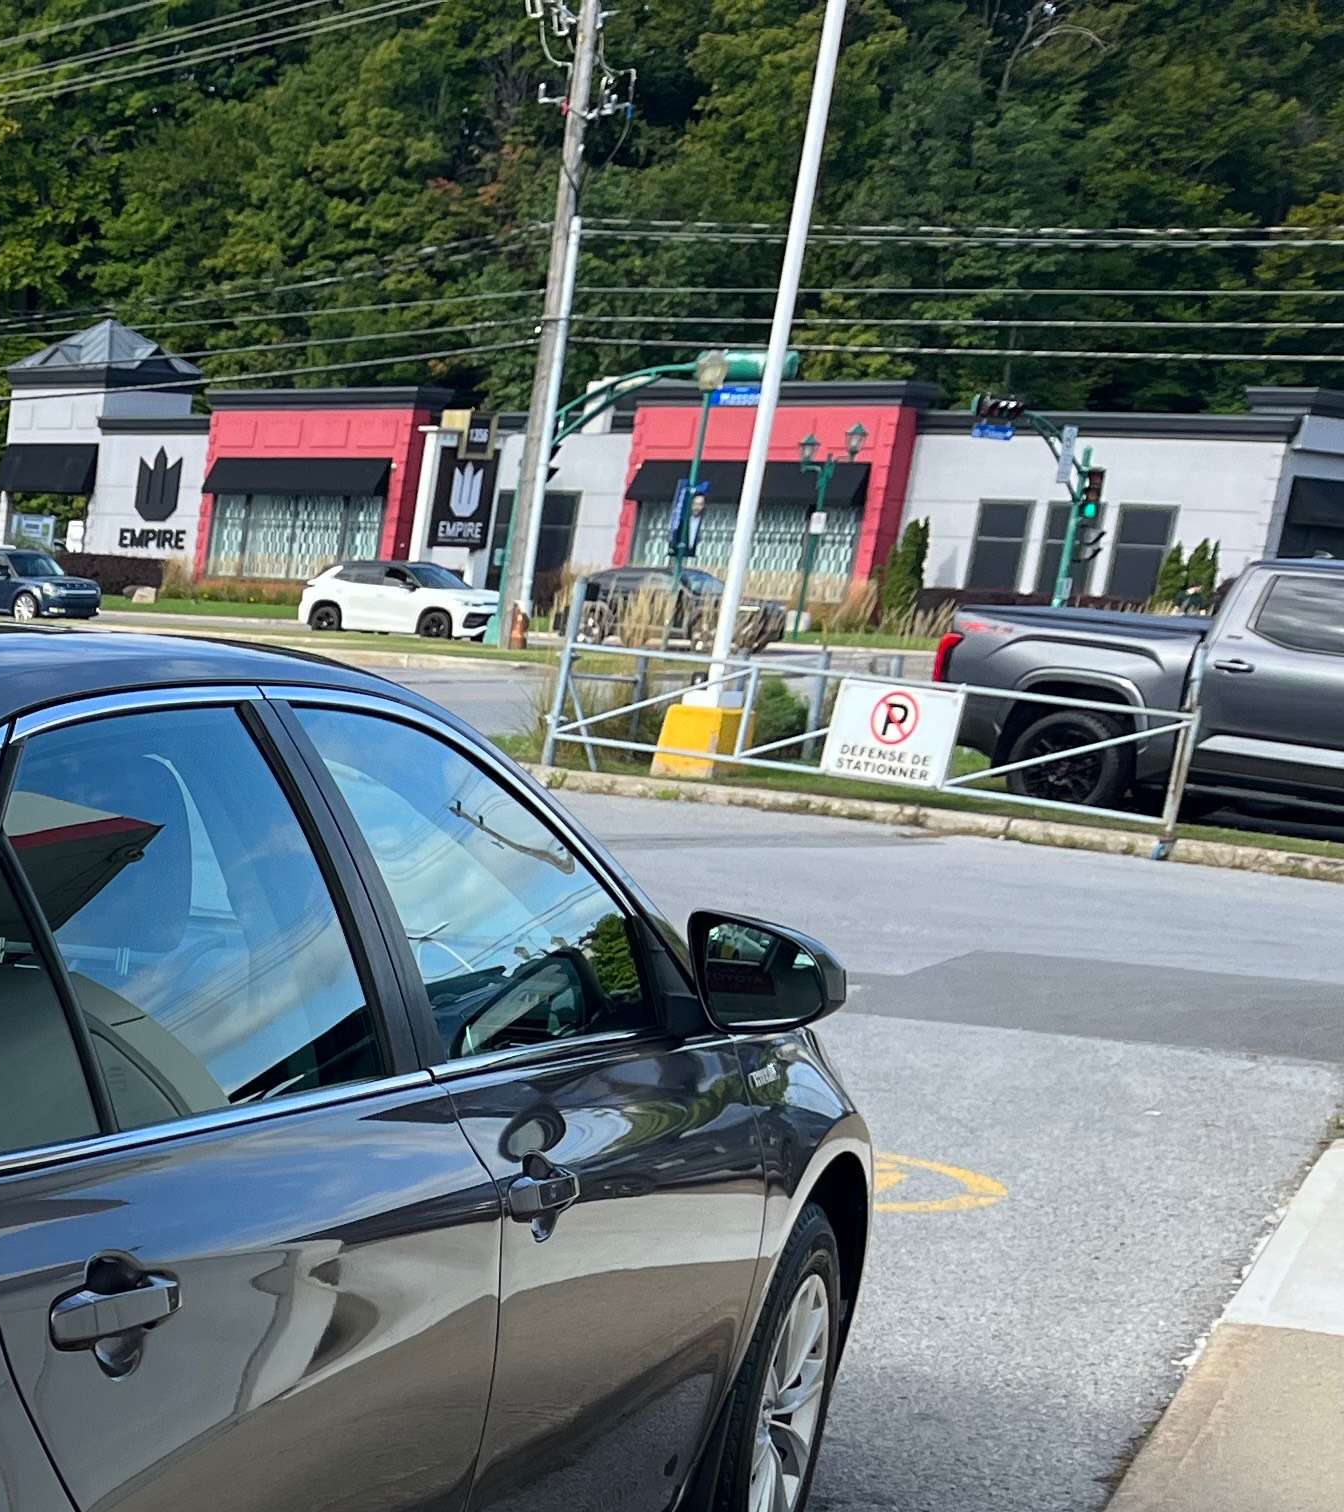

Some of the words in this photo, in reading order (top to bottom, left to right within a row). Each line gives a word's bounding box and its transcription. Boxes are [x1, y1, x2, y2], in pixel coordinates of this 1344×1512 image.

[118, 528, 186, 550] EMPIRE
[438, 520, 483, 539] EMPIRE
[835, 757, 929, 781] STATIONNER
[911, 754, 931, 767] DE
